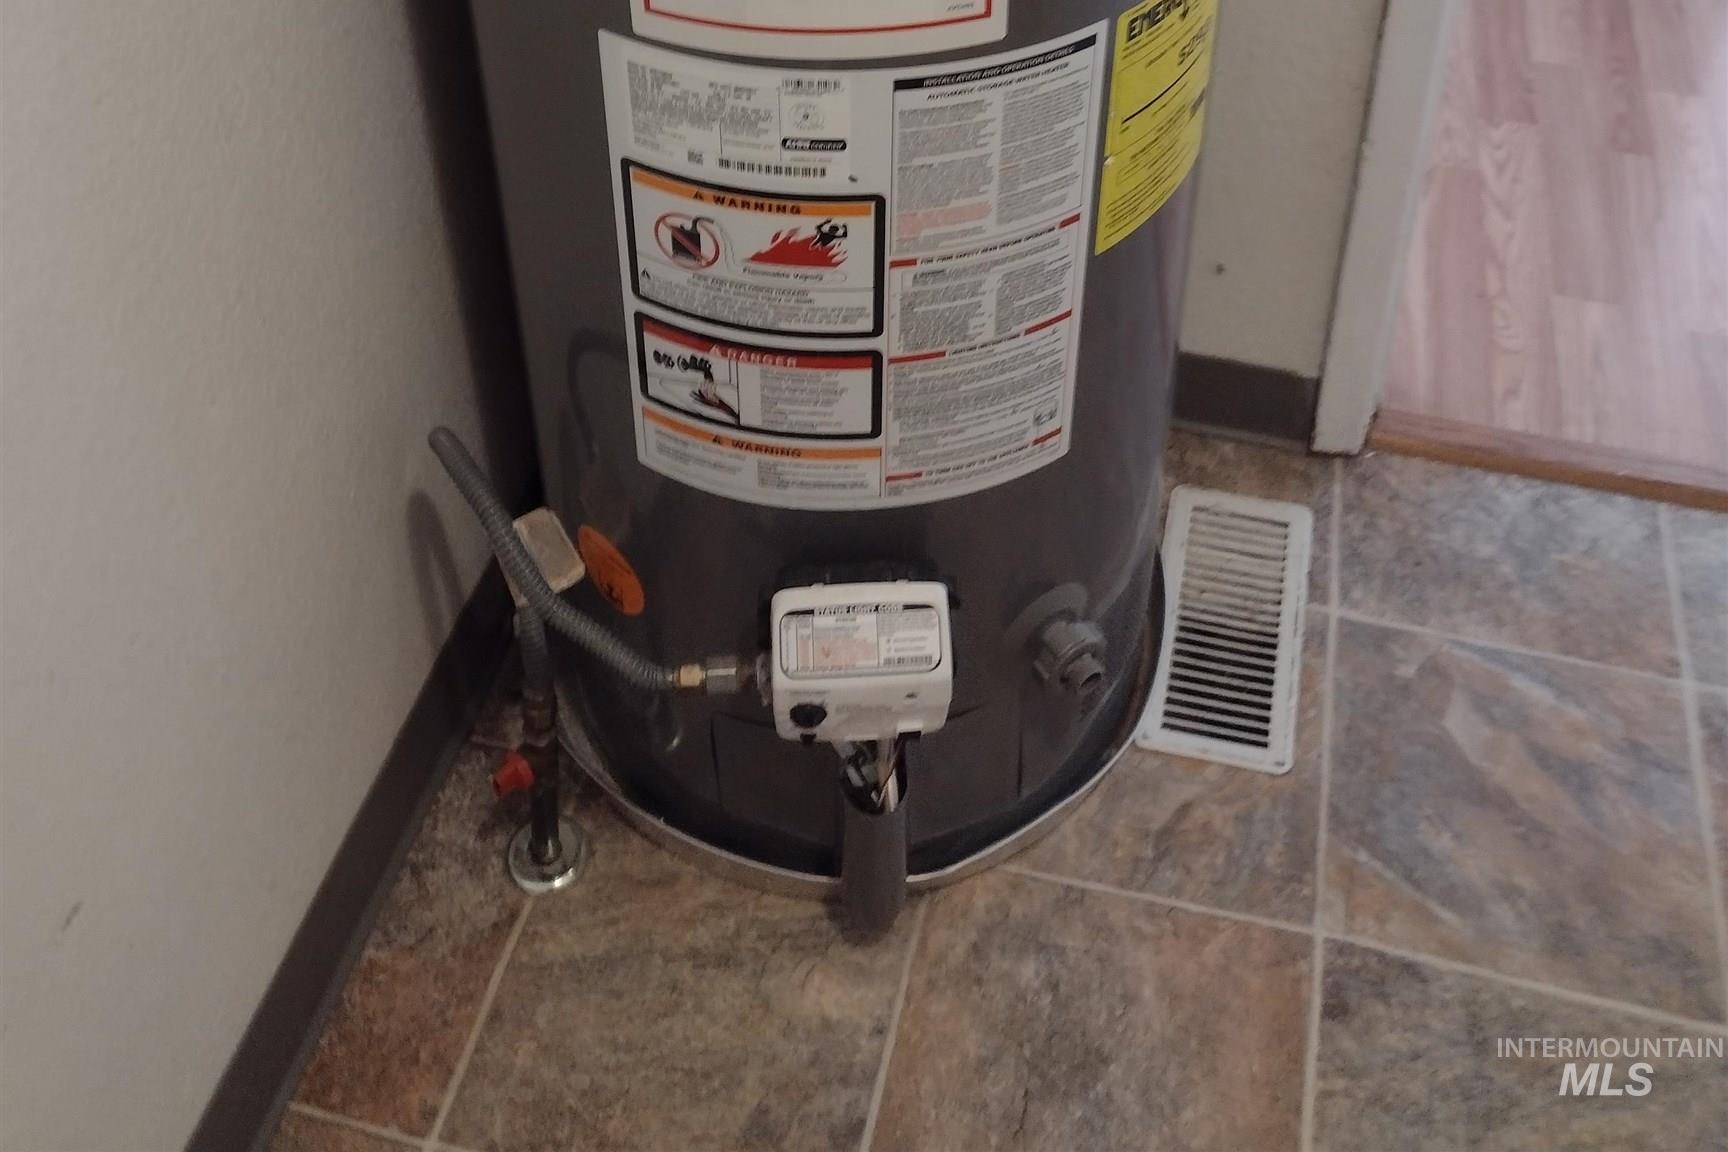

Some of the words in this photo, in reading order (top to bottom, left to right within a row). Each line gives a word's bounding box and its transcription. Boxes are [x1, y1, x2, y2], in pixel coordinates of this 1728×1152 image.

[713, 194, 801, 215] WARNING
[727, 348, 797, 368] DANGER
[731, 439, 802, 457] WARNING
